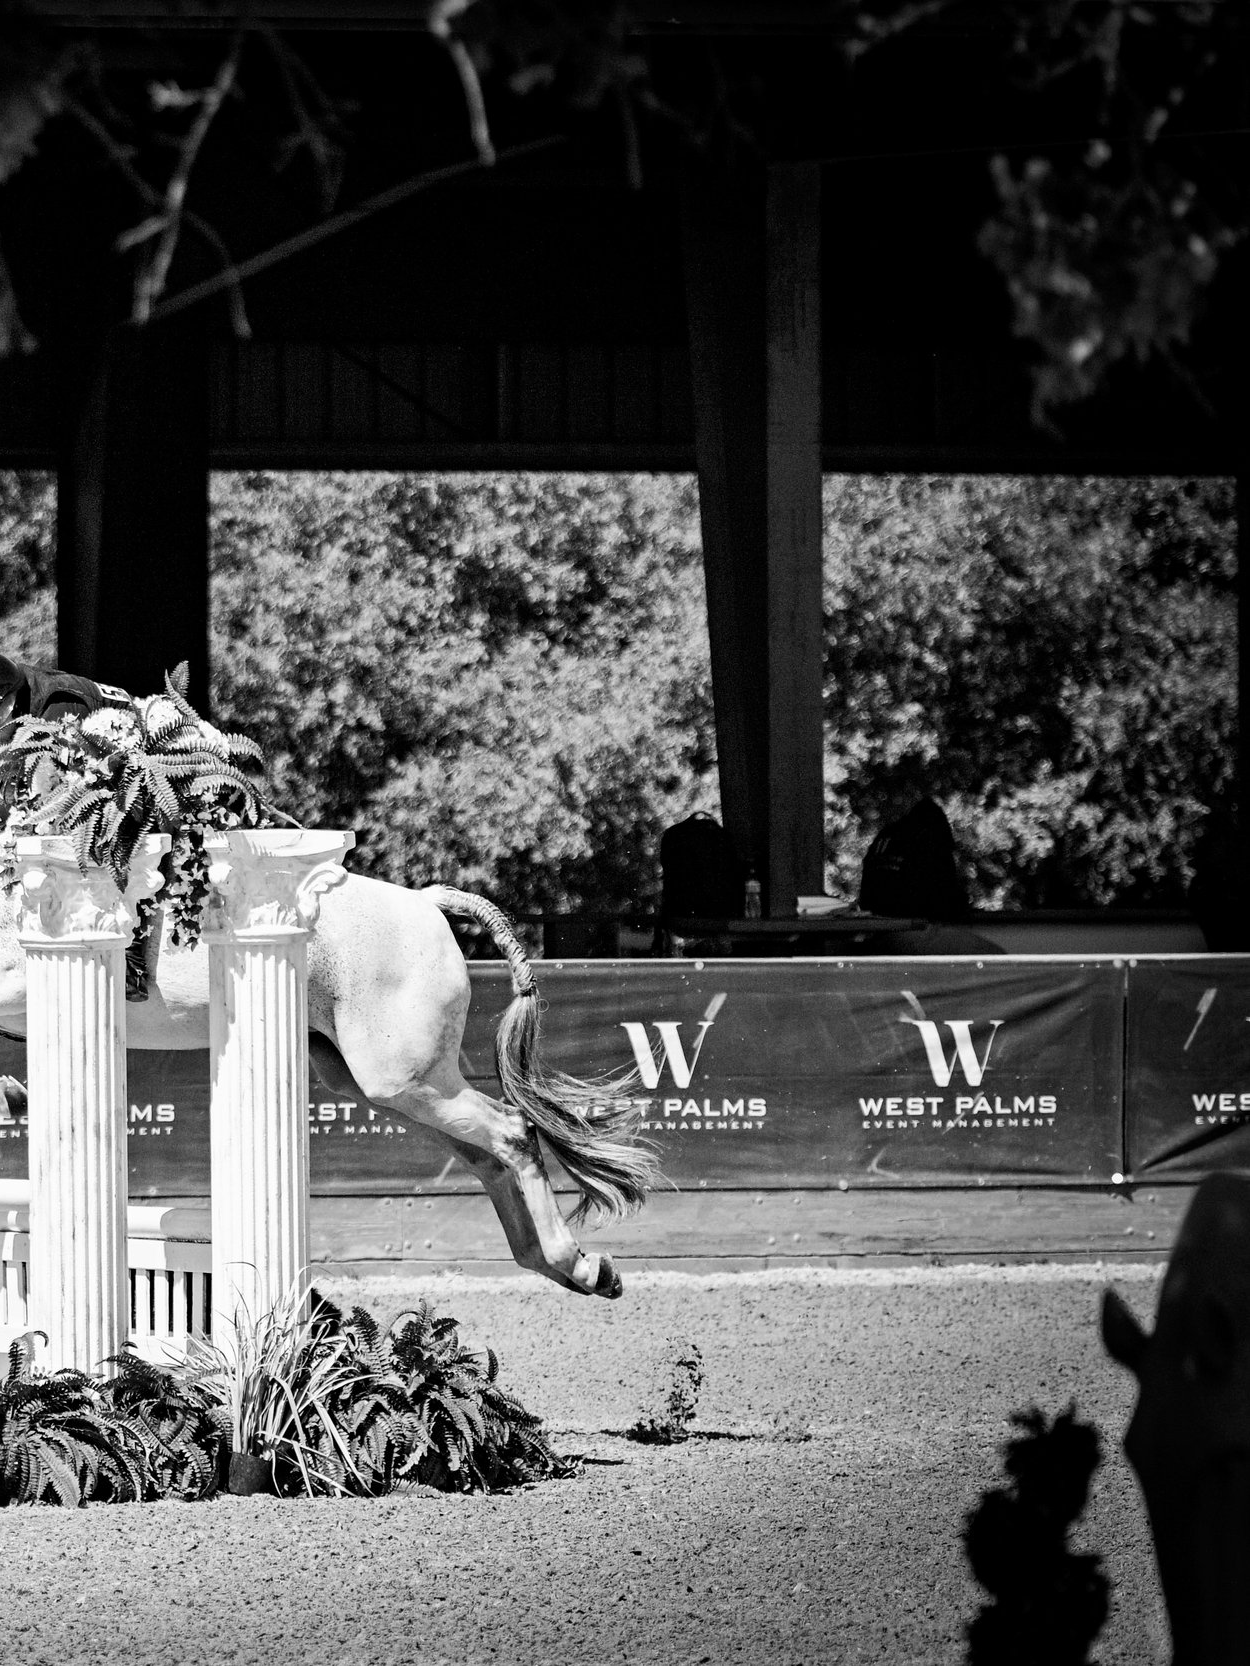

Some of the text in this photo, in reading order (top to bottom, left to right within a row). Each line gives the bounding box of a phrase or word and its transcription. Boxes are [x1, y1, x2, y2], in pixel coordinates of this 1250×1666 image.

[620, 1021, 714, 1089] W
[911, 1020, 1005, 1087] W
[664, 1098, 767, 1117] PALMS
[859, 1095, 1057, 1116] WEST PALMS
[1192, 1093, 1250, 1111] WES
[640, 1120, 765, 1130] MANAGEMENT
[862, 1117, 1056, 1129] EVENT MANAGEMENT
